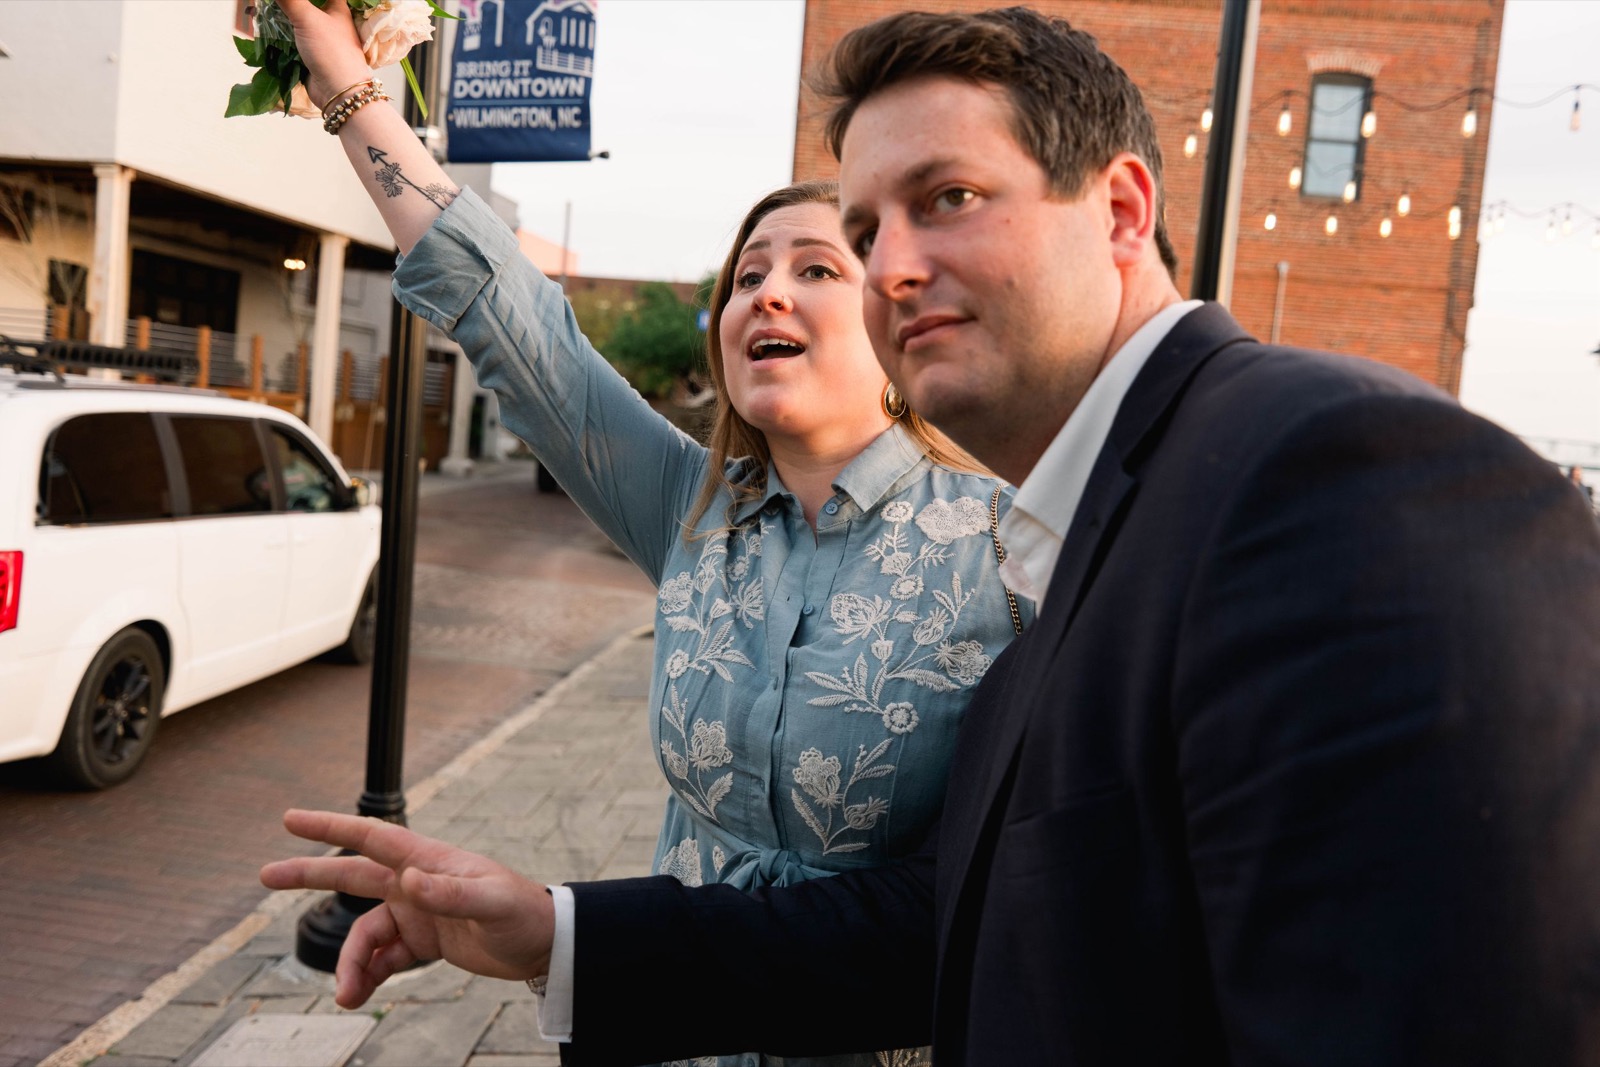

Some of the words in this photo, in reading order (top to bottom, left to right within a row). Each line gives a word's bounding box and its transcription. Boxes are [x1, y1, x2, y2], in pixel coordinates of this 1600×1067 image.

[456, 60, 511, 78] BRING
[513, 60, 533, 76] IT
[453, 77, 585, 99] DOWNTOWN
[453, 107, 557, 130] WILMINGTON,
[557, 107, 582, 128] NC
